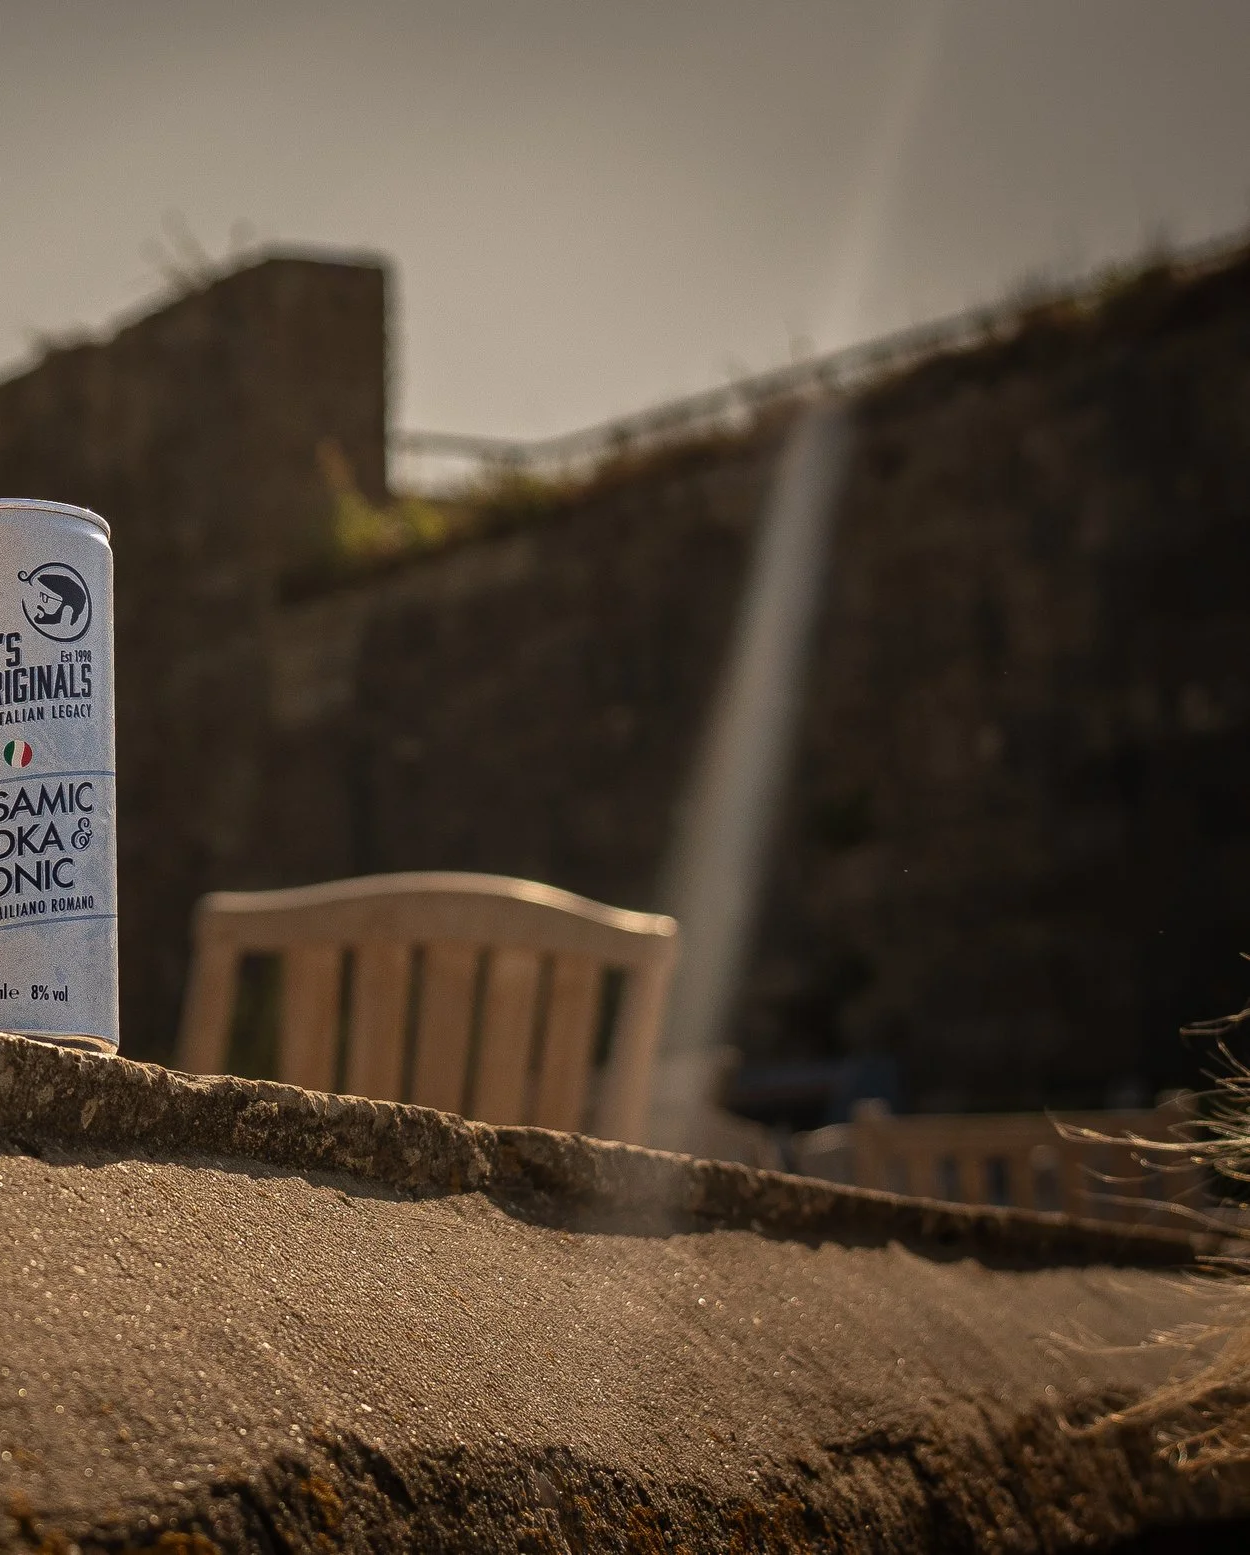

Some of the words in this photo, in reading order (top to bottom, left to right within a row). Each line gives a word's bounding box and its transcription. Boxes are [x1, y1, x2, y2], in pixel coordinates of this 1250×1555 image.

[60, 650, 72, 662] Est
[52, 704, 92, 719] LEGACY
[71, 817, 92, 850] &
[51, 896, 94, 912] ROMANO
[31, 985, 49, 1000] 8%
[53, 985, 68, 1002] vol
